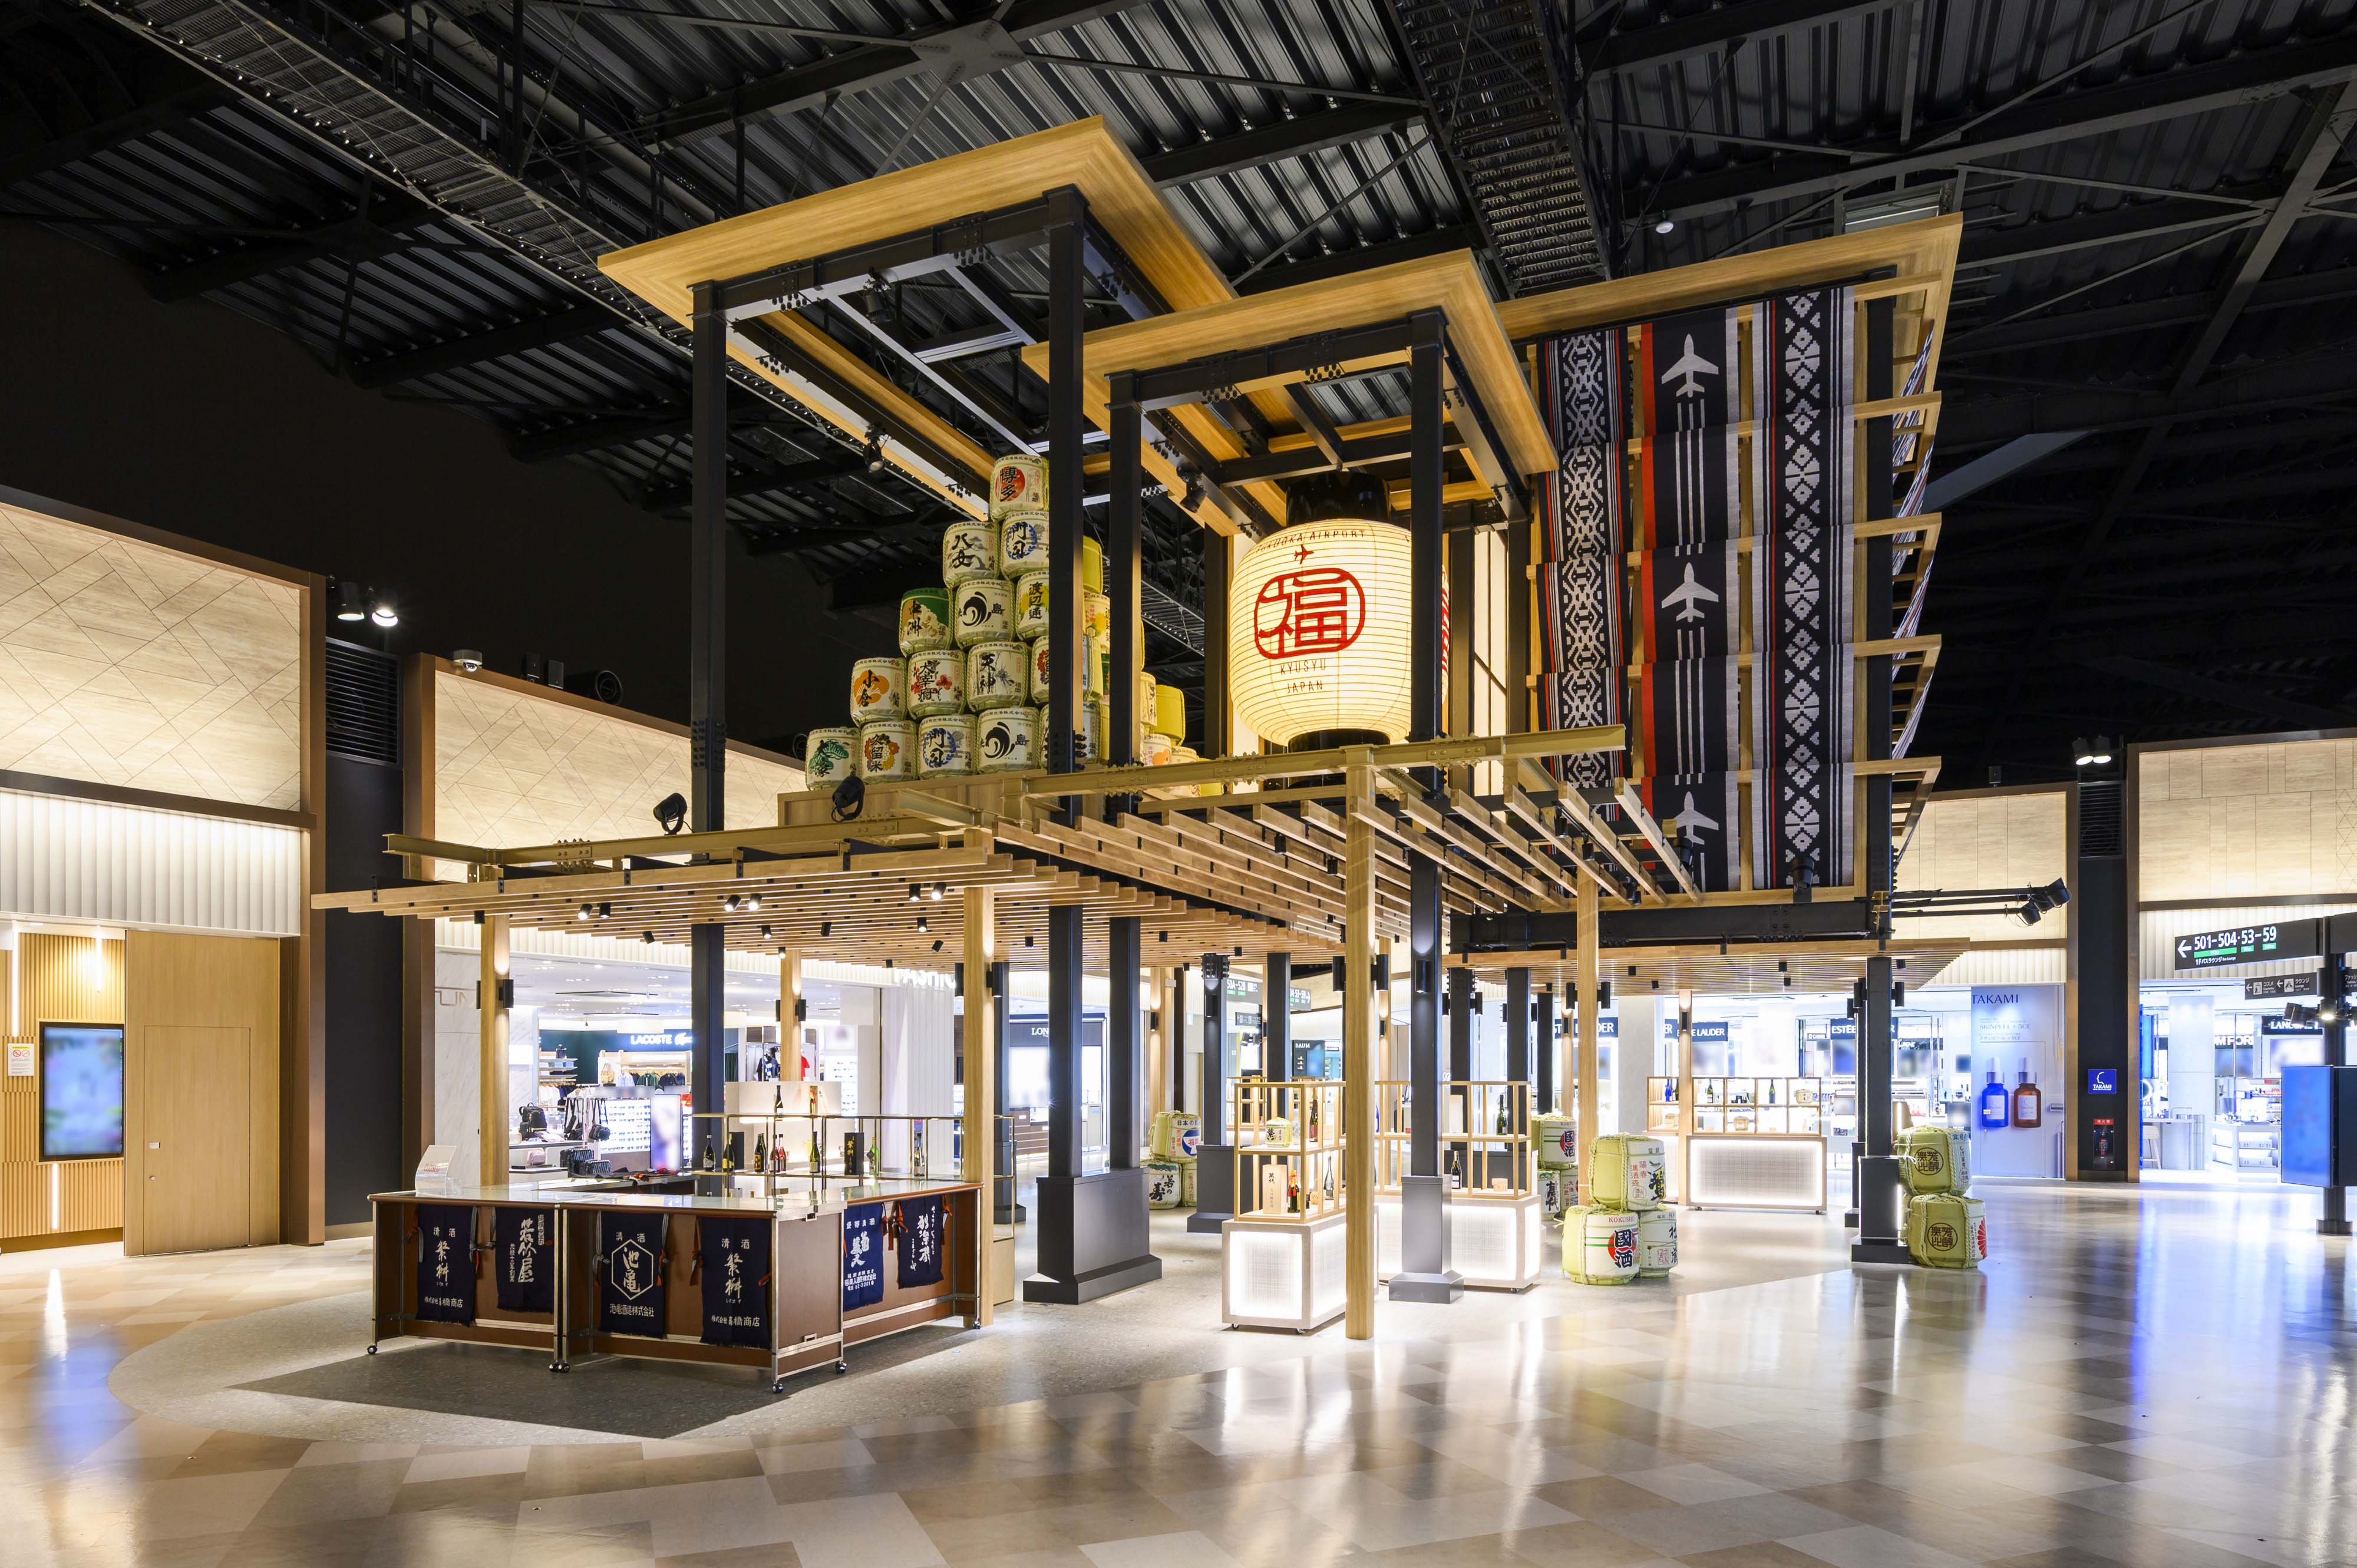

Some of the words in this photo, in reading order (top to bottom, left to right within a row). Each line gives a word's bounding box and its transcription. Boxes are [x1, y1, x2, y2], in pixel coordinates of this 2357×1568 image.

[1000, 467, 1017, 501] 博多
[952, 533, 975, 569] 八女
[1012, 522, 1026, 558] 門司
[1256, 533, 1302, 553] FUKUOKA
[1309, 530, 1365, 540] AIRPORT
[1028, 581, 1044, 619] 渡辺通
[1254, 567, 1365, 659] 福
[918, 662, 935, 702] 太宰府
[980, 653, 996, 693] 天神
[1280, 658, 1326, 675] KYUSYU
[859, 669, 880, 707] 小倉
[1288, 680, 1323, 694] JAPAN
[871, 734, 884, 773] 久留米
[929, 732, 944, 765] 門司
[1972, 994, 2018, 1004] TAKAMI
[630, 1034, 672, 1045] LACOSTE
[1696, 1028, 1725, 1036] LAUDER
[1639, 1160, 1647, 1179] 陽春
[517, 1217, 537, 1282] 若竹屋
[721, 1238, 750, 1250] 清酒
[1615, 1229, 1633, 1269] 國酒
[622, 1246, 641, 1293] 池亀
